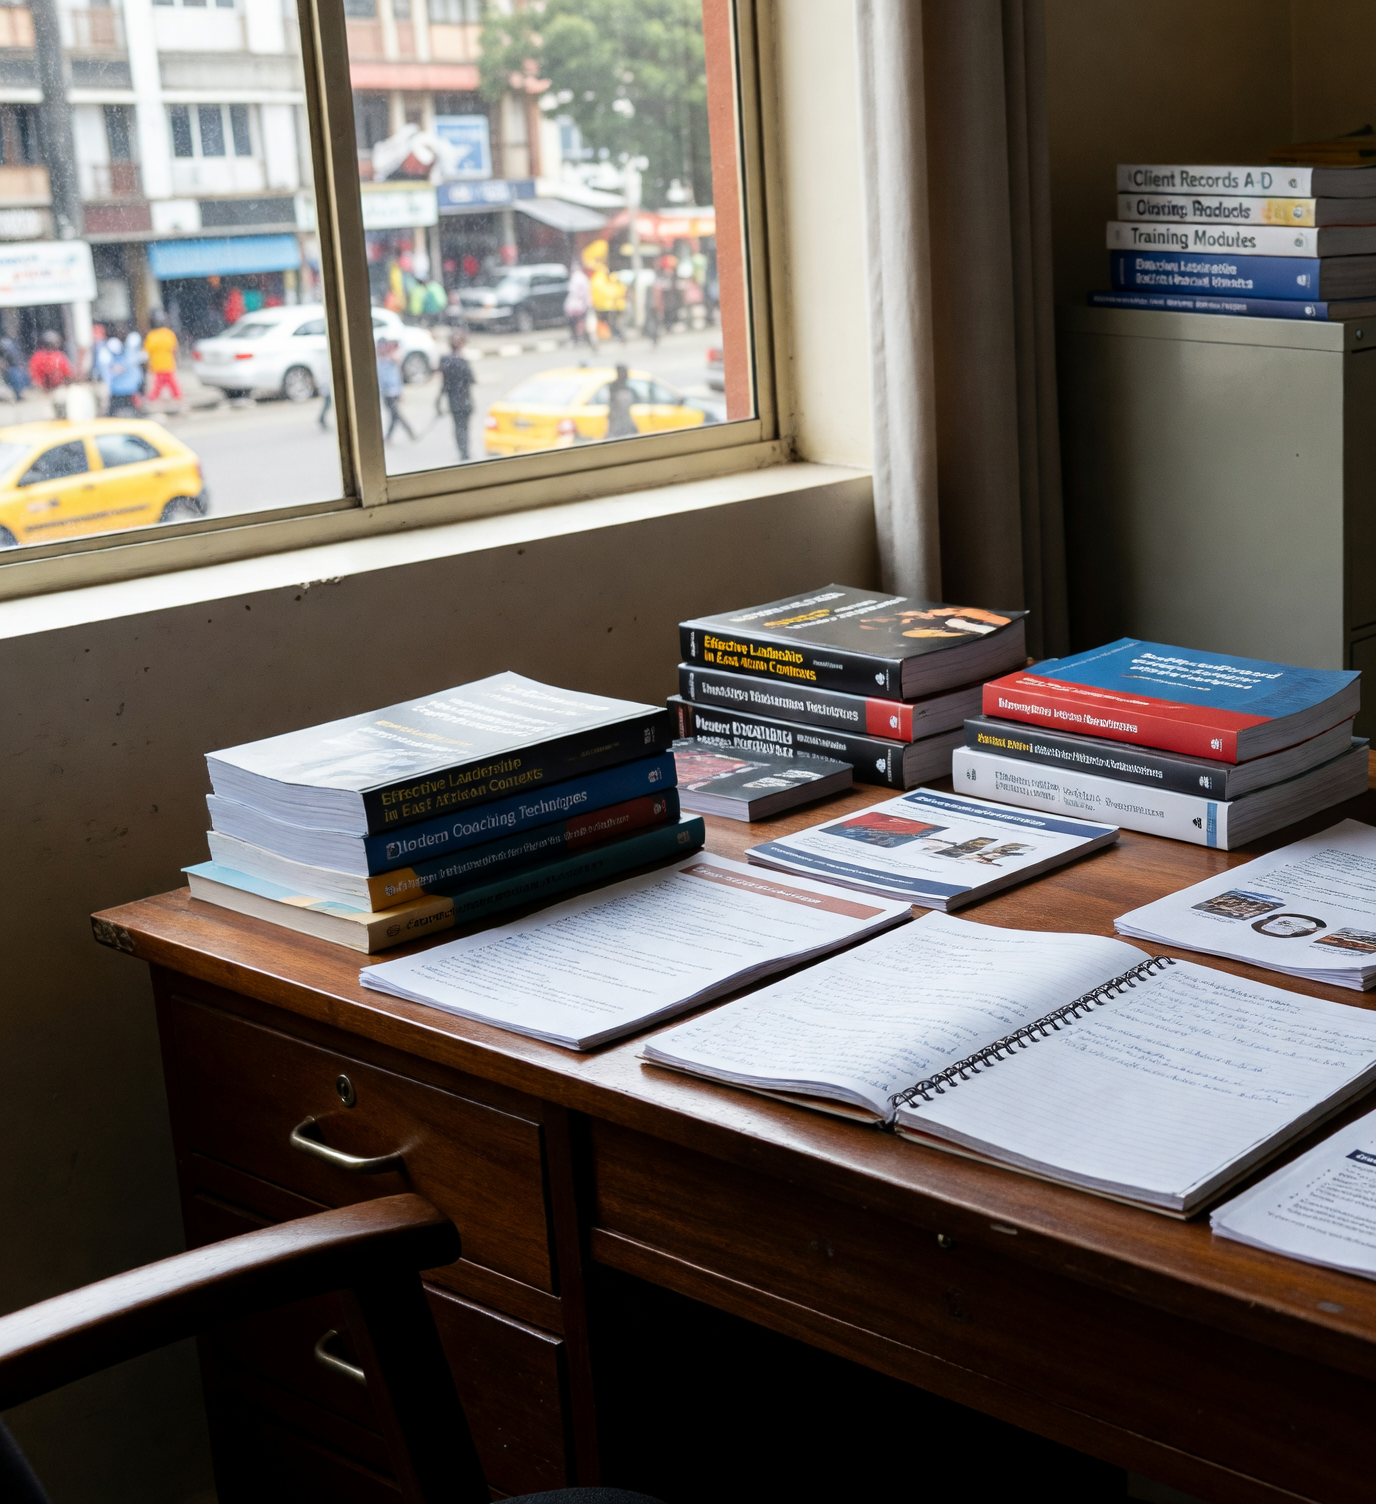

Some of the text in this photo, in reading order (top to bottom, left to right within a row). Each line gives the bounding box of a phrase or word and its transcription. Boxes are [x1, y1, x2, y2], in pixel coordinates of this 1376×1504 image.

[1132, 169, 1176, 188] Client
[1180, 170, 1240, 189] Records
[1131, 227, 1189, 250] Training
